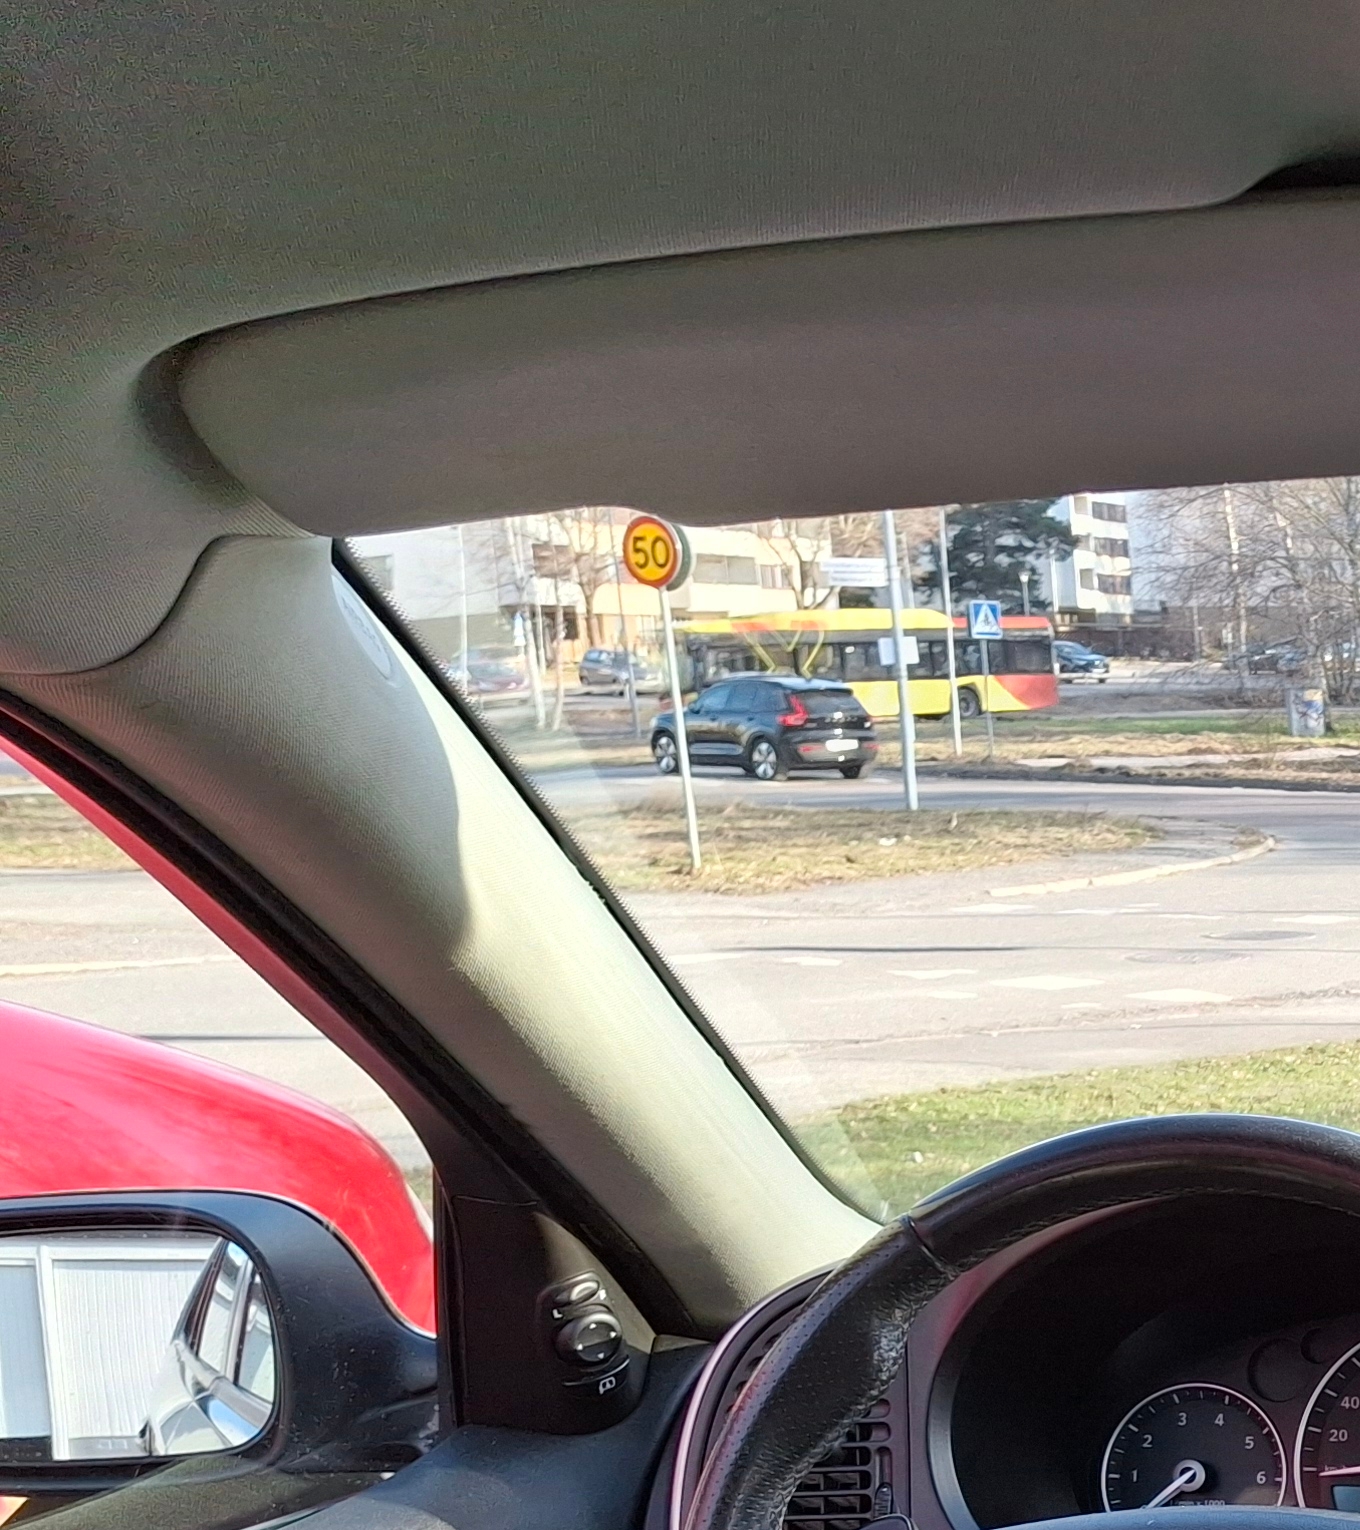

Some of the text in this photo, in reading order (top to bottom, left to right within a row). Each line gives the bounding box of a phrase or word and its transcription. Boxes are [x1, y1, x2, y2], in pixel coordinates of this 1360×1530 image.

[632, 535, 670, 569] 50
[552, 1309, 563, 1320] L
[1341, 1396, 1360, 1409] 40
[1178, 1412, 1187, 1426] 3
[1214, 1413, 1225, 1427] 4
[1142, 1434, 1153, 1448] 2
[1329, 1429, 1348, 1442] 20
[1245, 1436, 1254, 1449] 5
[1131, 1469, 1138, 1482] 1
[1256, 1471, 1266, 1484] 6
